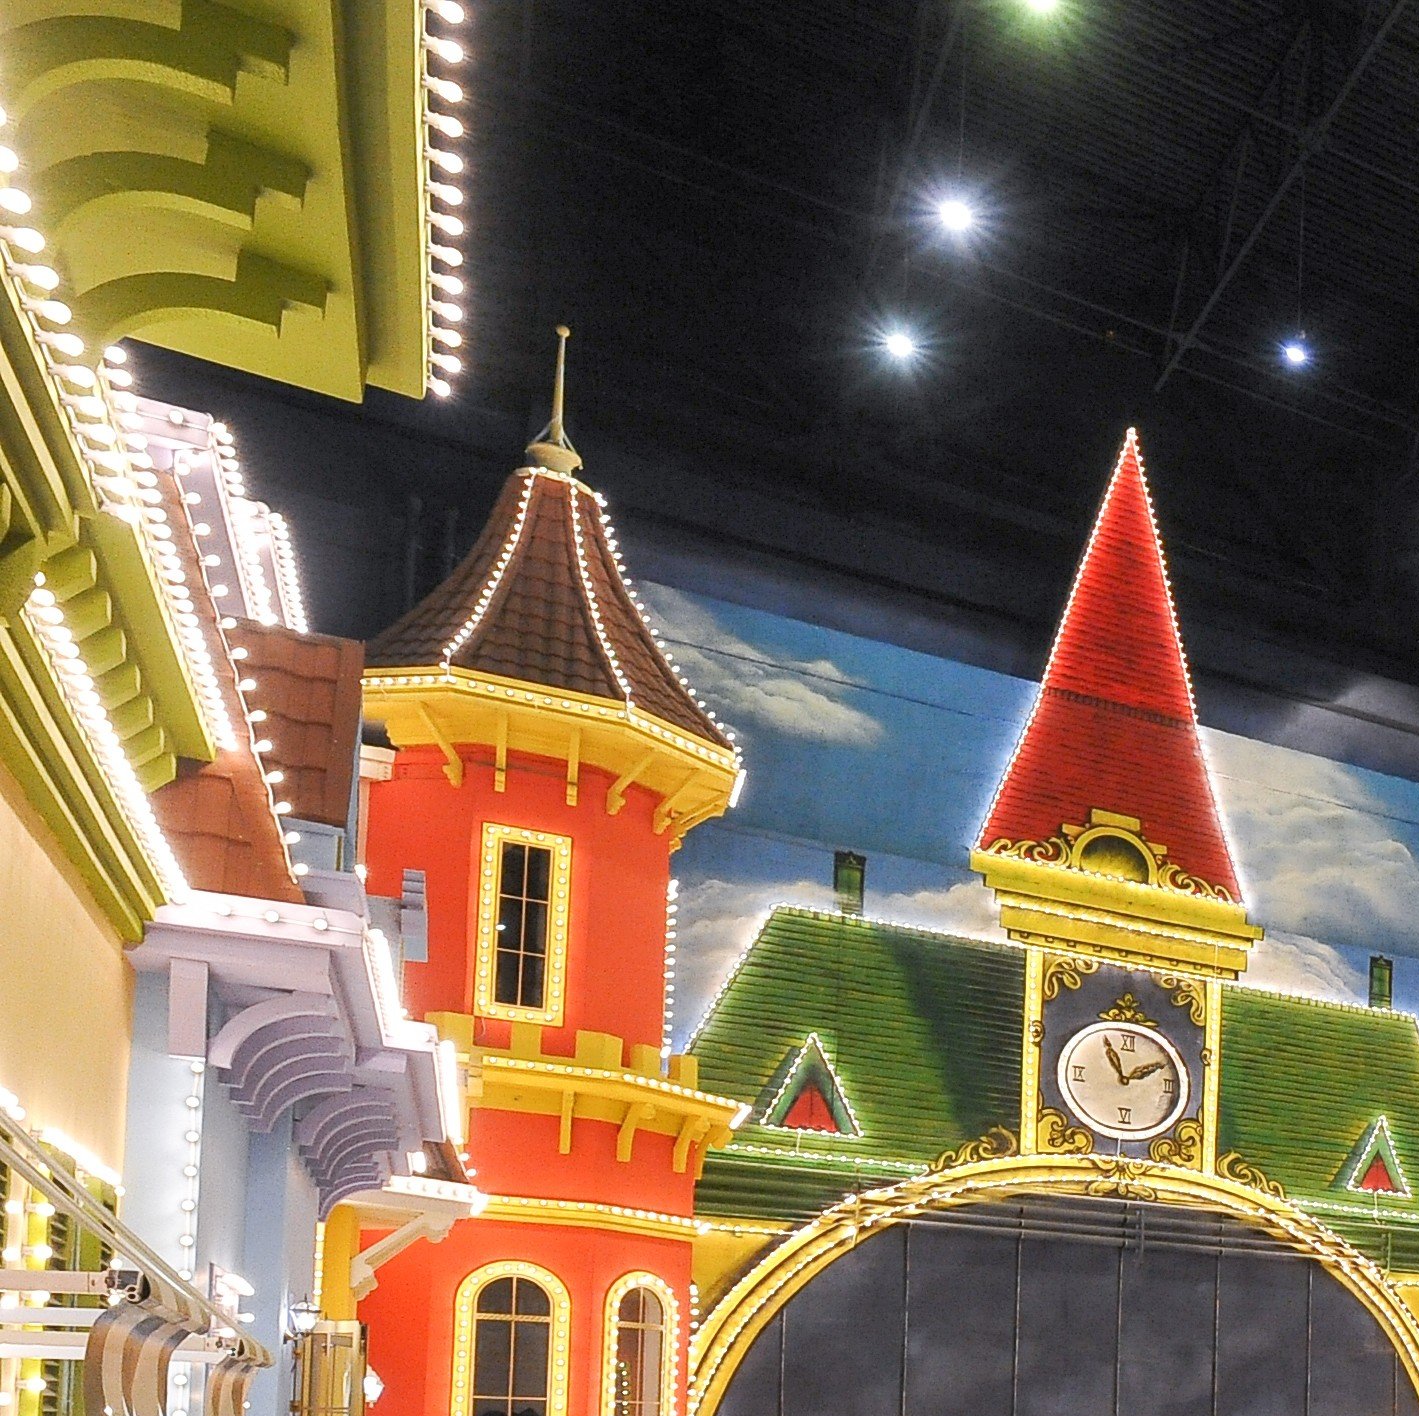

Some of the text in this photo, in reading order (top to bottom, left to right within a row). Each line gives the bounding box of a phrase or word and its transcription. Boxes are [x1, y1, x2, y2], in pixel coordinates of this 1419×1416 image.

[1121, 1034, 1135, 1052] XII
[1072, 1065, 1085, 1082] IX
[1118, 1107, 1131, 1124] VI
